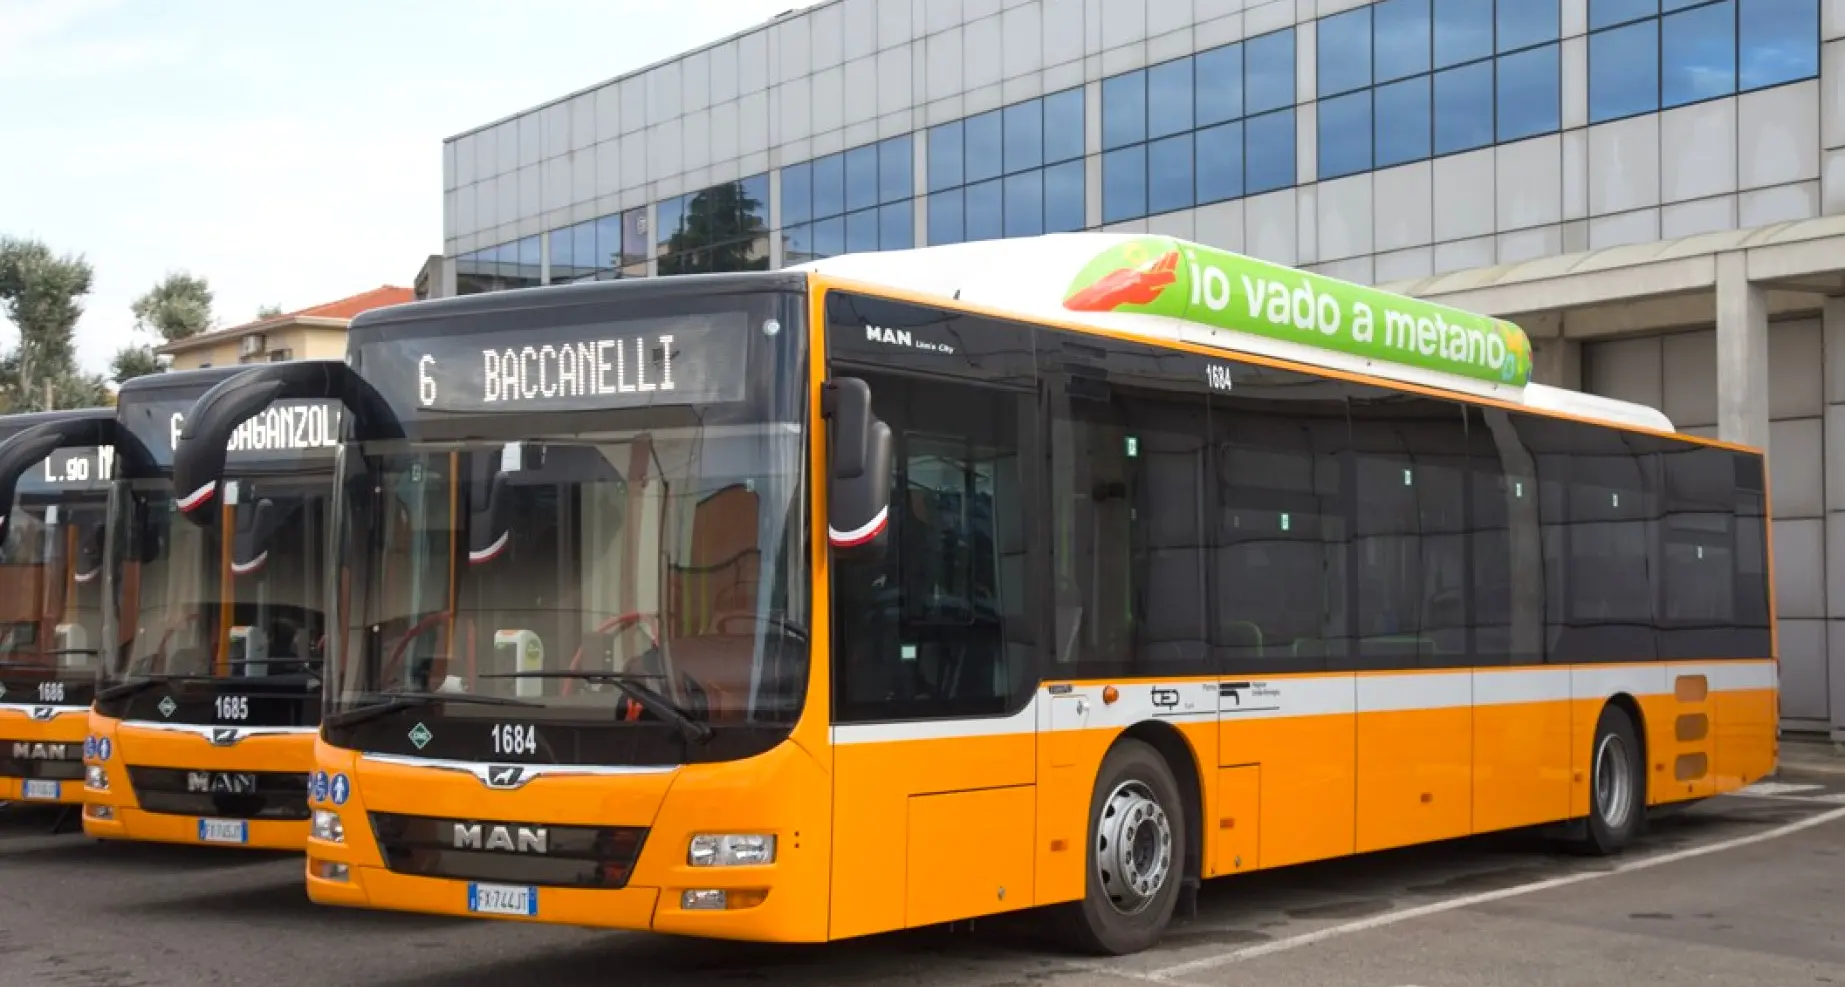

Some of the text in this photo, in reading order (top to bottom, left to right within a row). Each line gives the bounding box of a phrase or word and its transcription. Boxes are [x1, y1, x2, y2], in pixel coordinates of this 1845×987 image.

[1186, 250, 1506, 369] io vado a metano
[866, 325, 912, 346] MAN
[418, 334, 675, 405] 6 BACCANELLI
[1205, 363, 1233, 391] 1684
[215, 696, 249, 719] 1685
[13, 742, 66, 759] MAN
[491, 724, 537, 754] 1684
[187, 771, 256, 793] MAN
[453, 823, 548, 853] MAN
